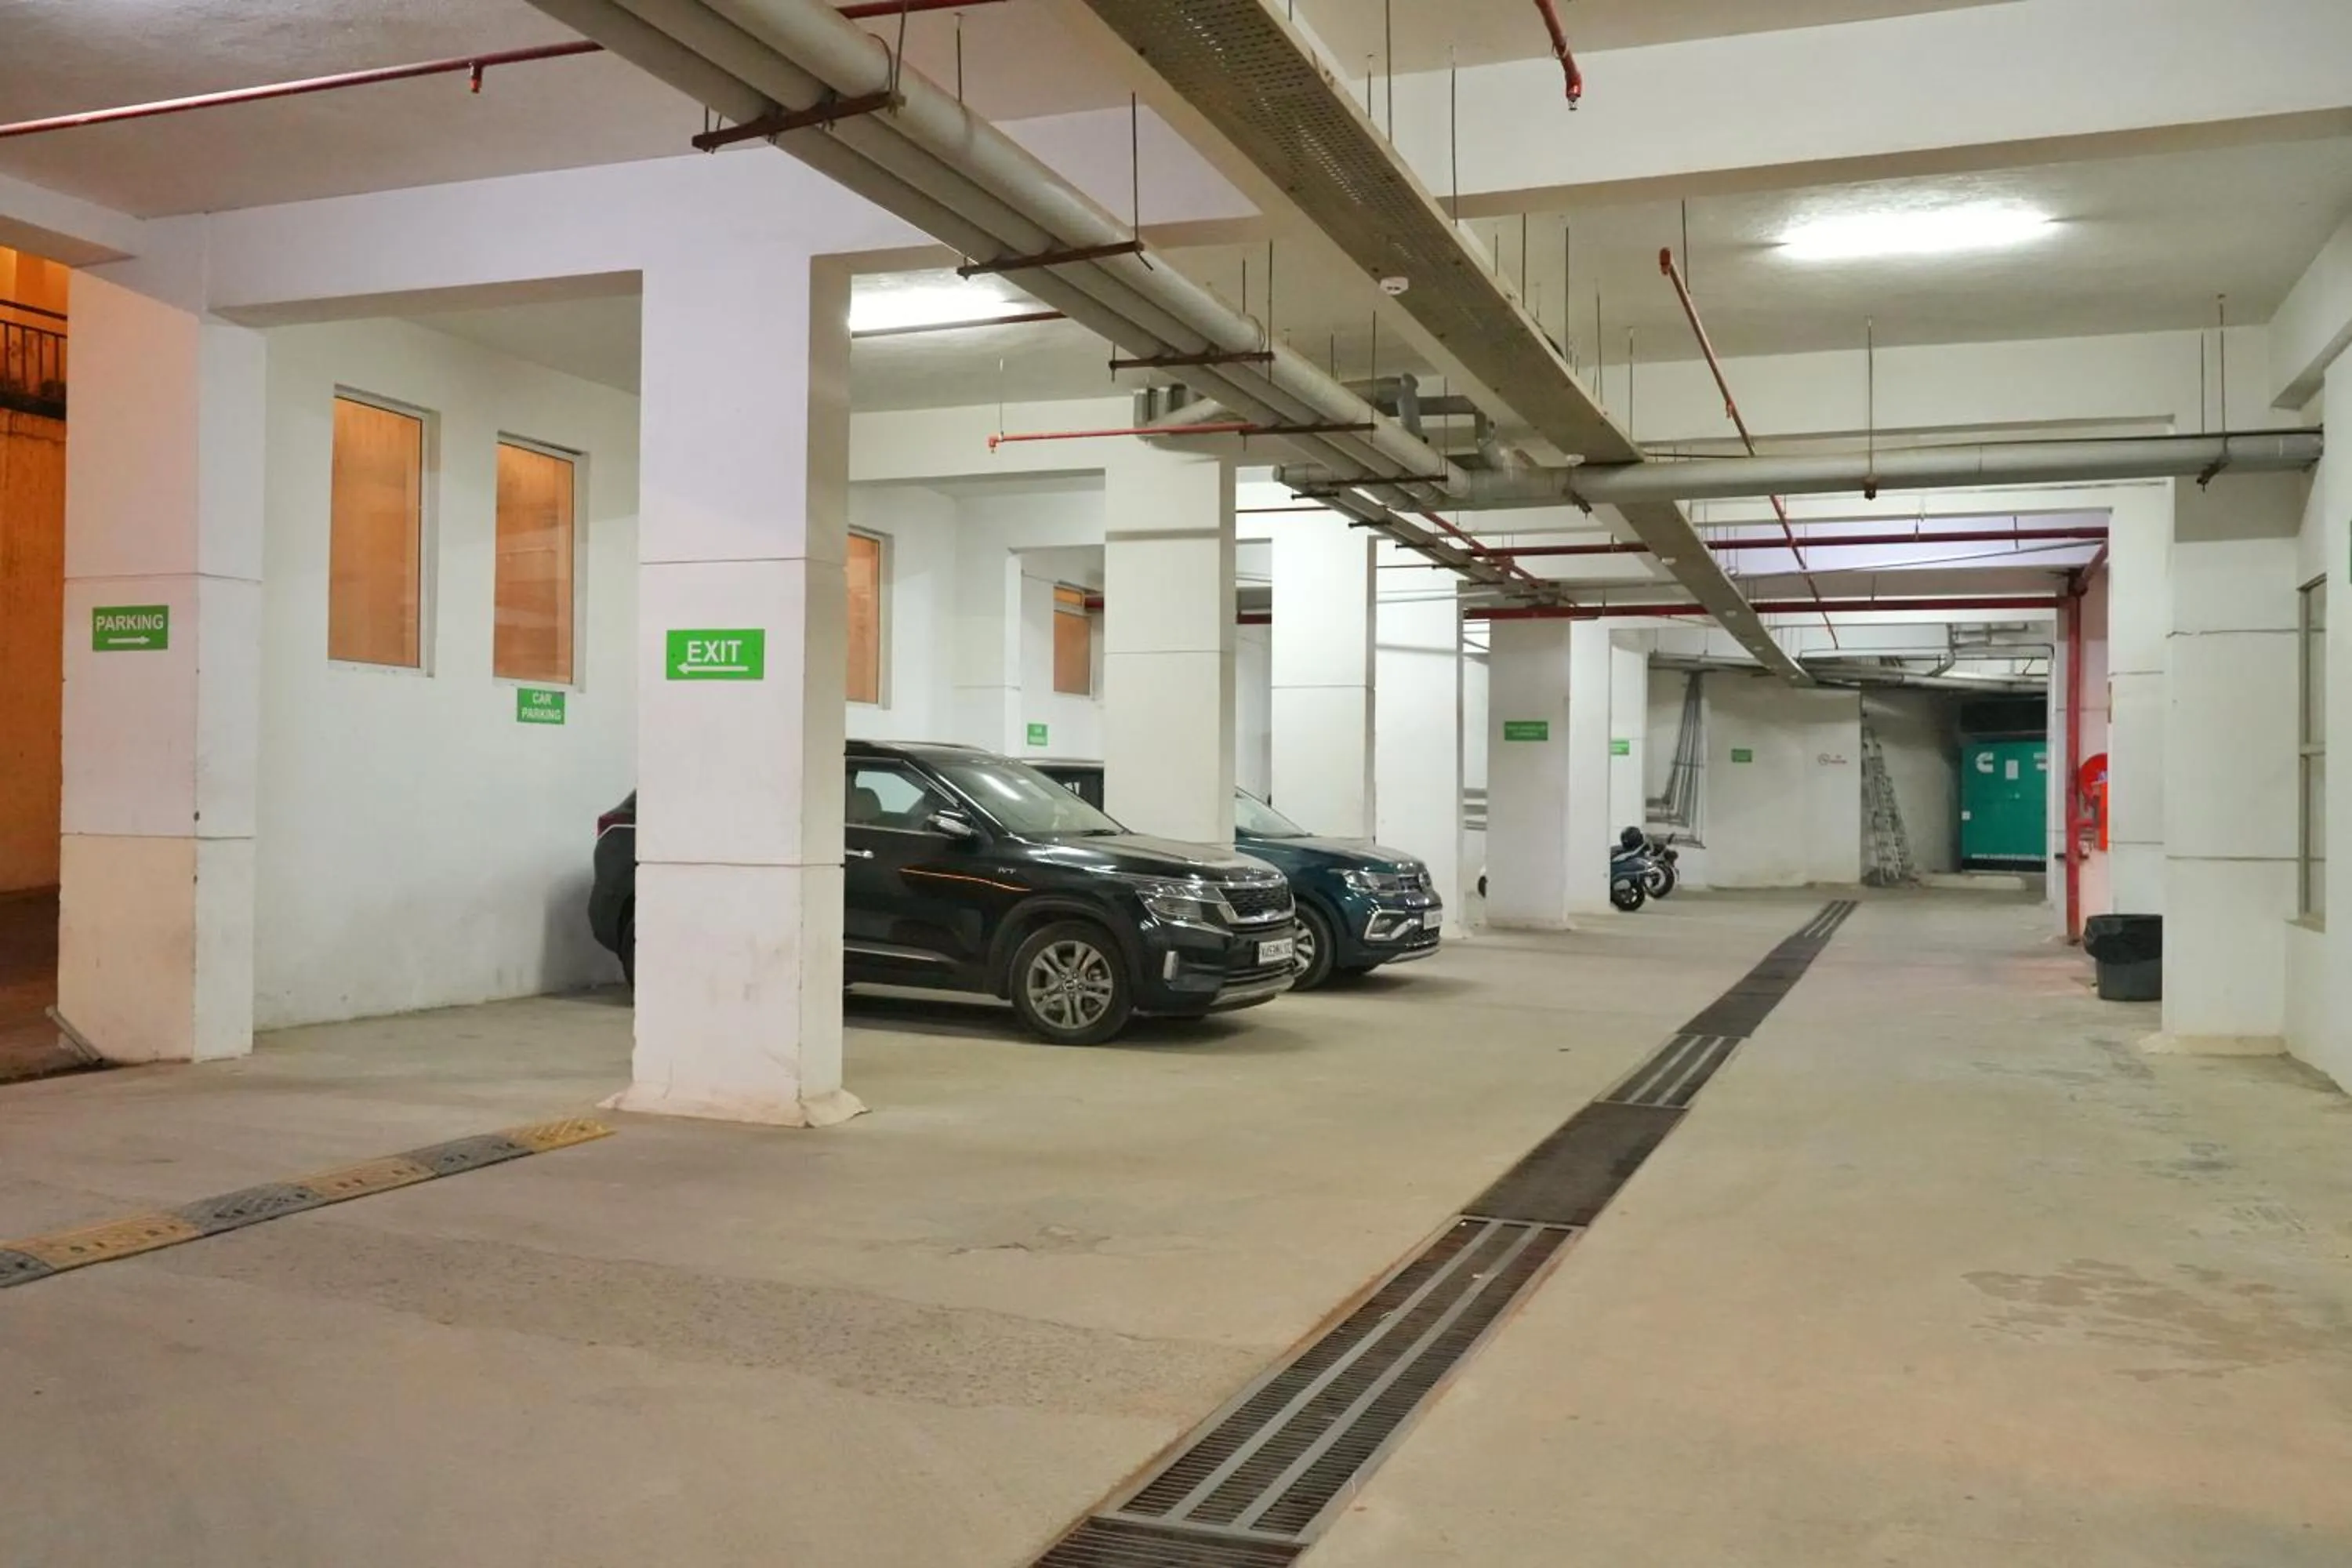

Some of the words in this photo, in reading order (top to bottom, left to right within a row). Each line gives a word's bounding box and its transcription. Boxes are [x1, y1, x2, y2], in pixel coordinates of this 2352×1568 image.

[96, 614, 164, 632] PARKING
[688, 640, 743, 662] EXIT
[532, 691, 553, 705] CAR
[521, 706, 562, 720] PARKING
